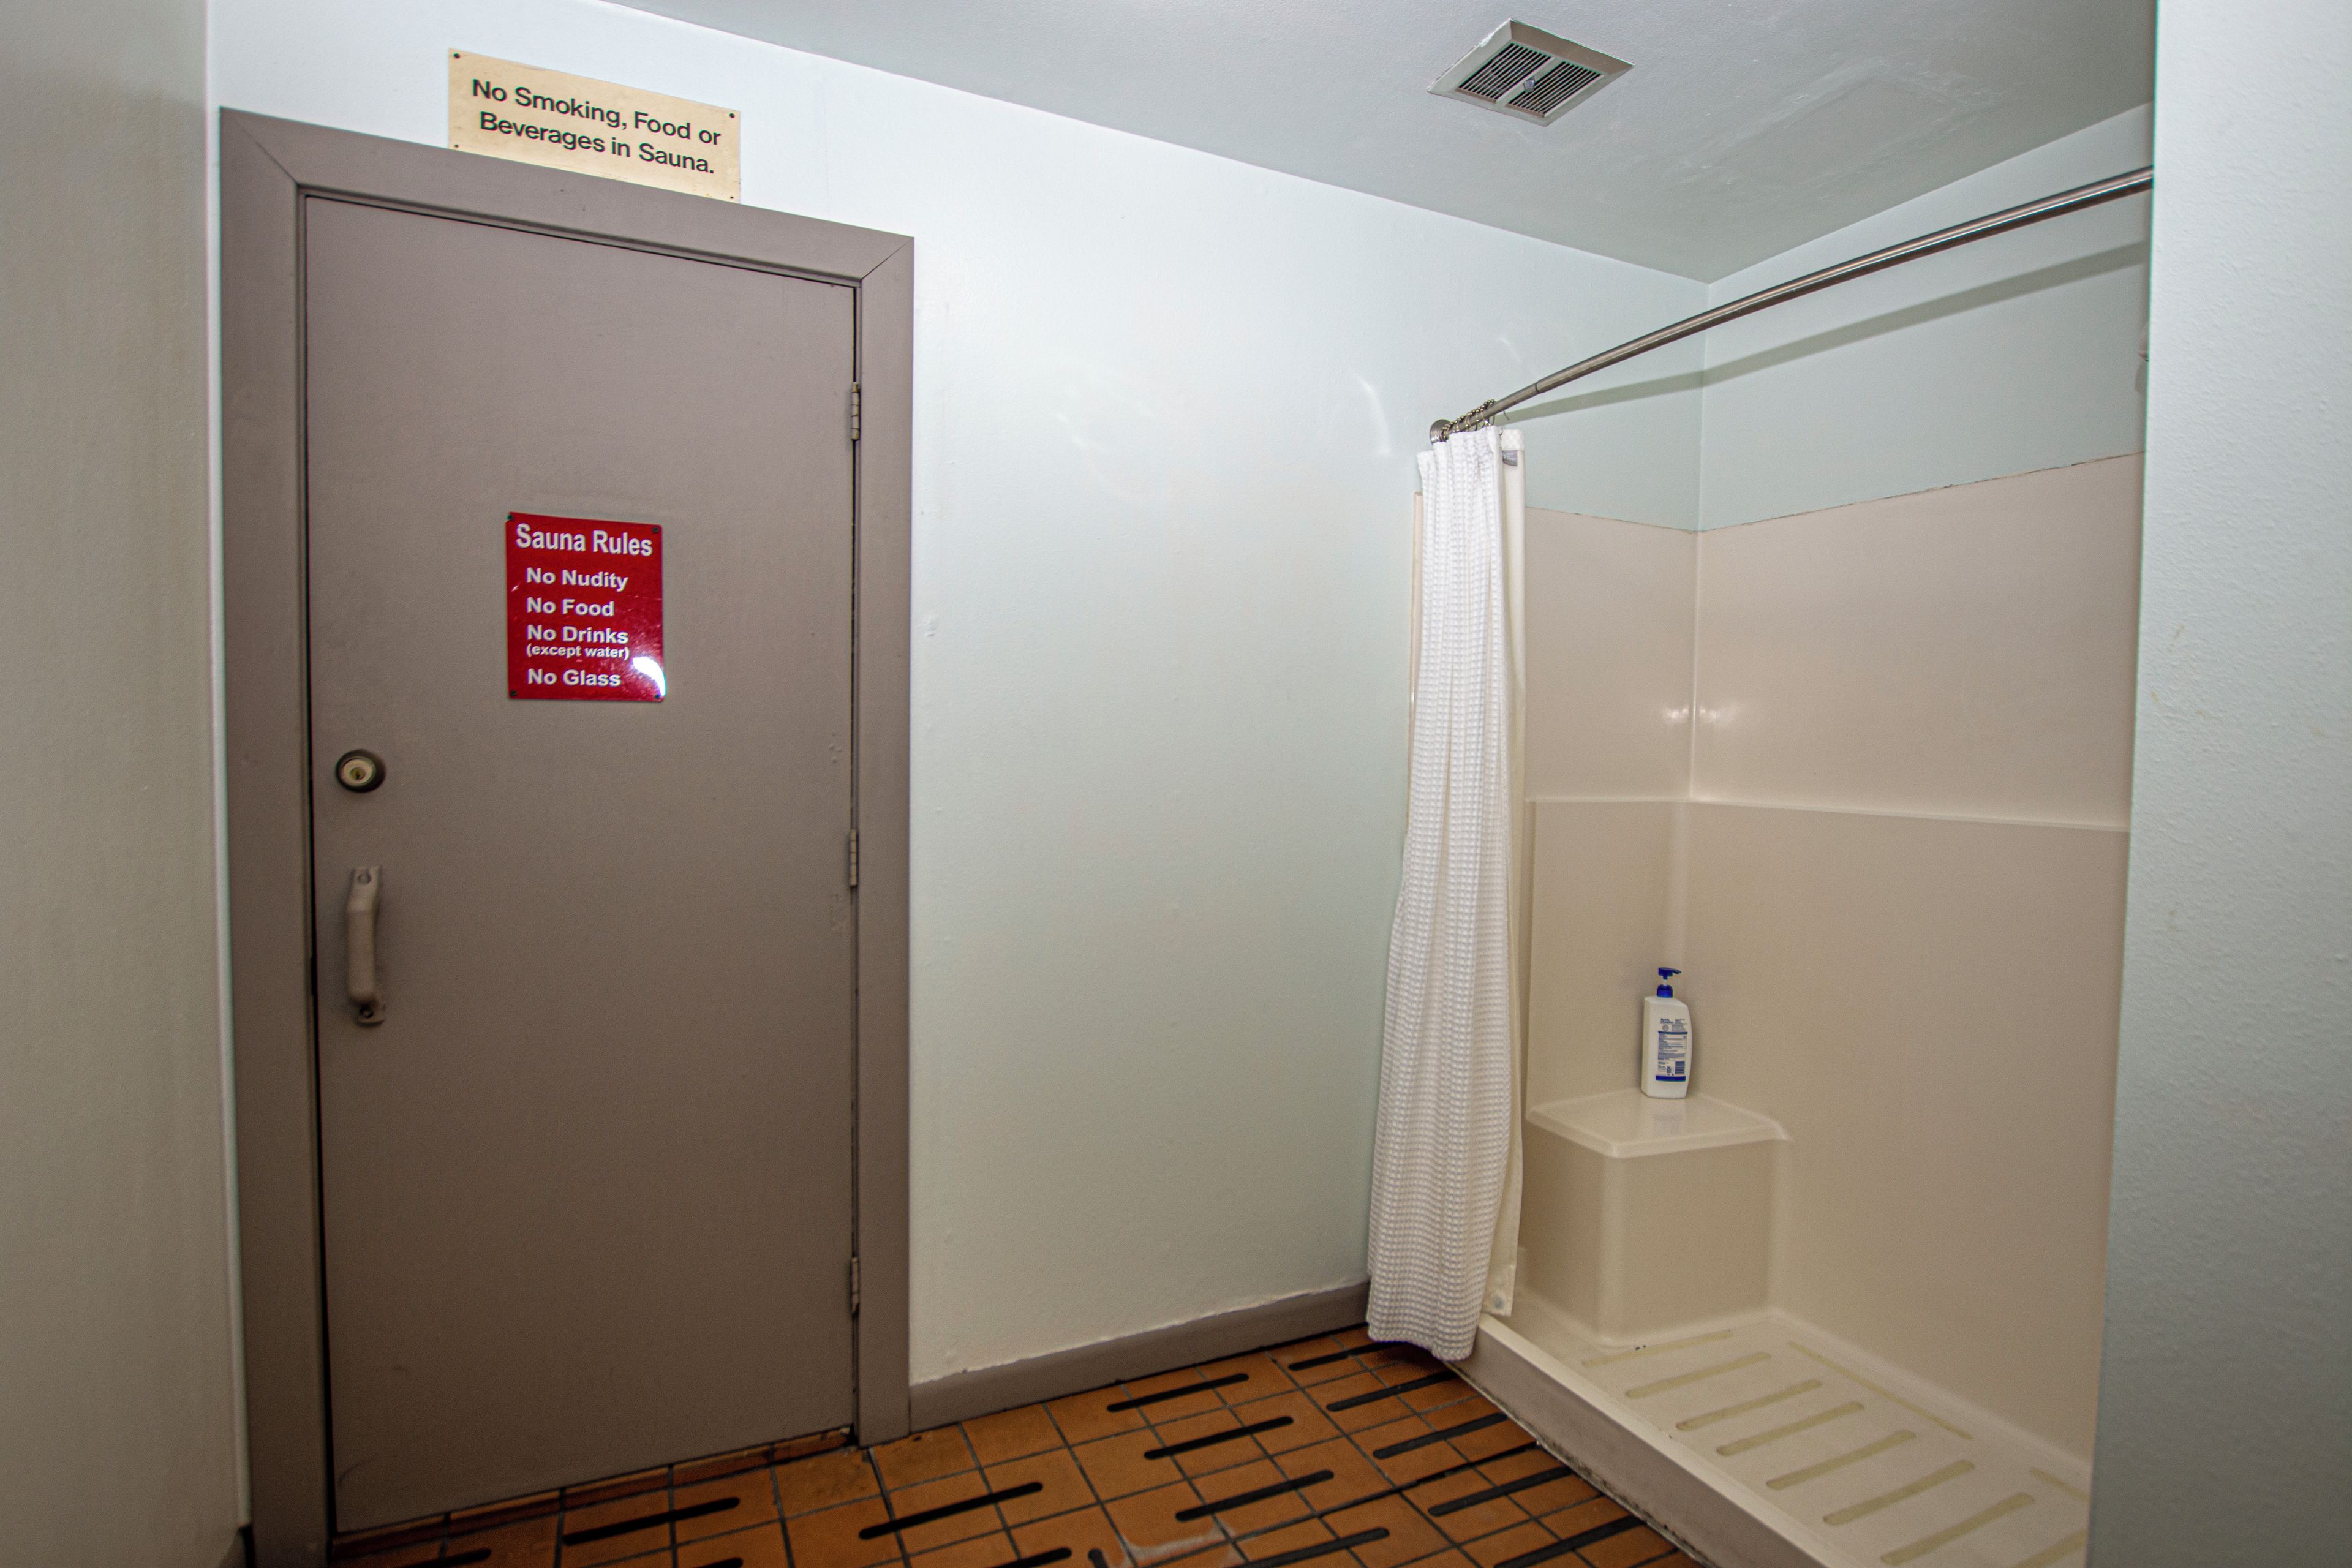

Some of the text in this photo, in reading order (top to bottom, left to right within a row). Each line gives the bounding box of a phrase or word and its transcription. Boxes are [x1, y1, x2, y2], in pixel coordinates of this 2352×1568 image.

[472, 78, 722, 145] No Smoking, Food or
[480, 111, 715, 174] Beverages in Sauna.
[516, 523, 654, 556] Sauna Rules
[526, 567, 629, 592] No Nudity
[526, 597, 615, 617] No Food
[527, 625, 630, 644] No Drinks
[526, 643, 630, 661] (except water)
[527, 668, 622, 687] No Glass
